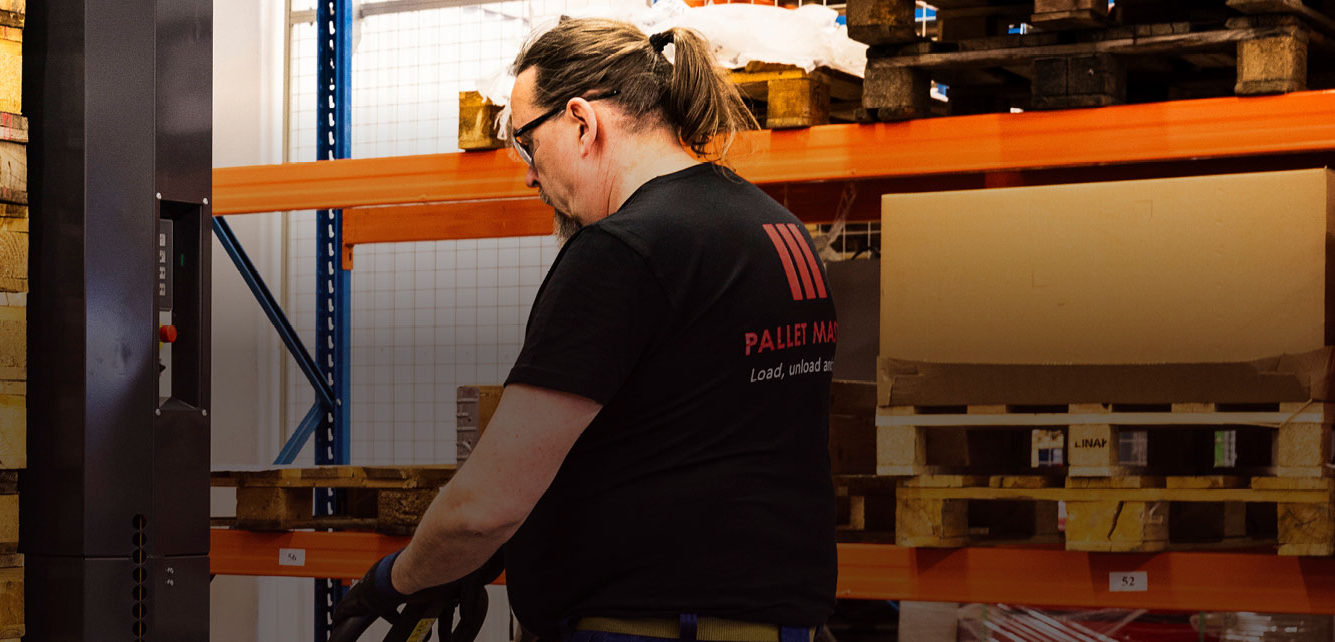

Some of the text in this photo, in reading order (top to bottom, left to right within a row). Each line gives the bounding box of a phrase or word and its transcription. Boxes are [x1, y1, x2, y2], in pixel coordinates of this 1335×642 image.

[745, 322, 807, 356] PALLET
[750, 362, 785, 383] Load,
[789, 356, 821, 376] unload
[1122, 576, 1135, 586] 52
